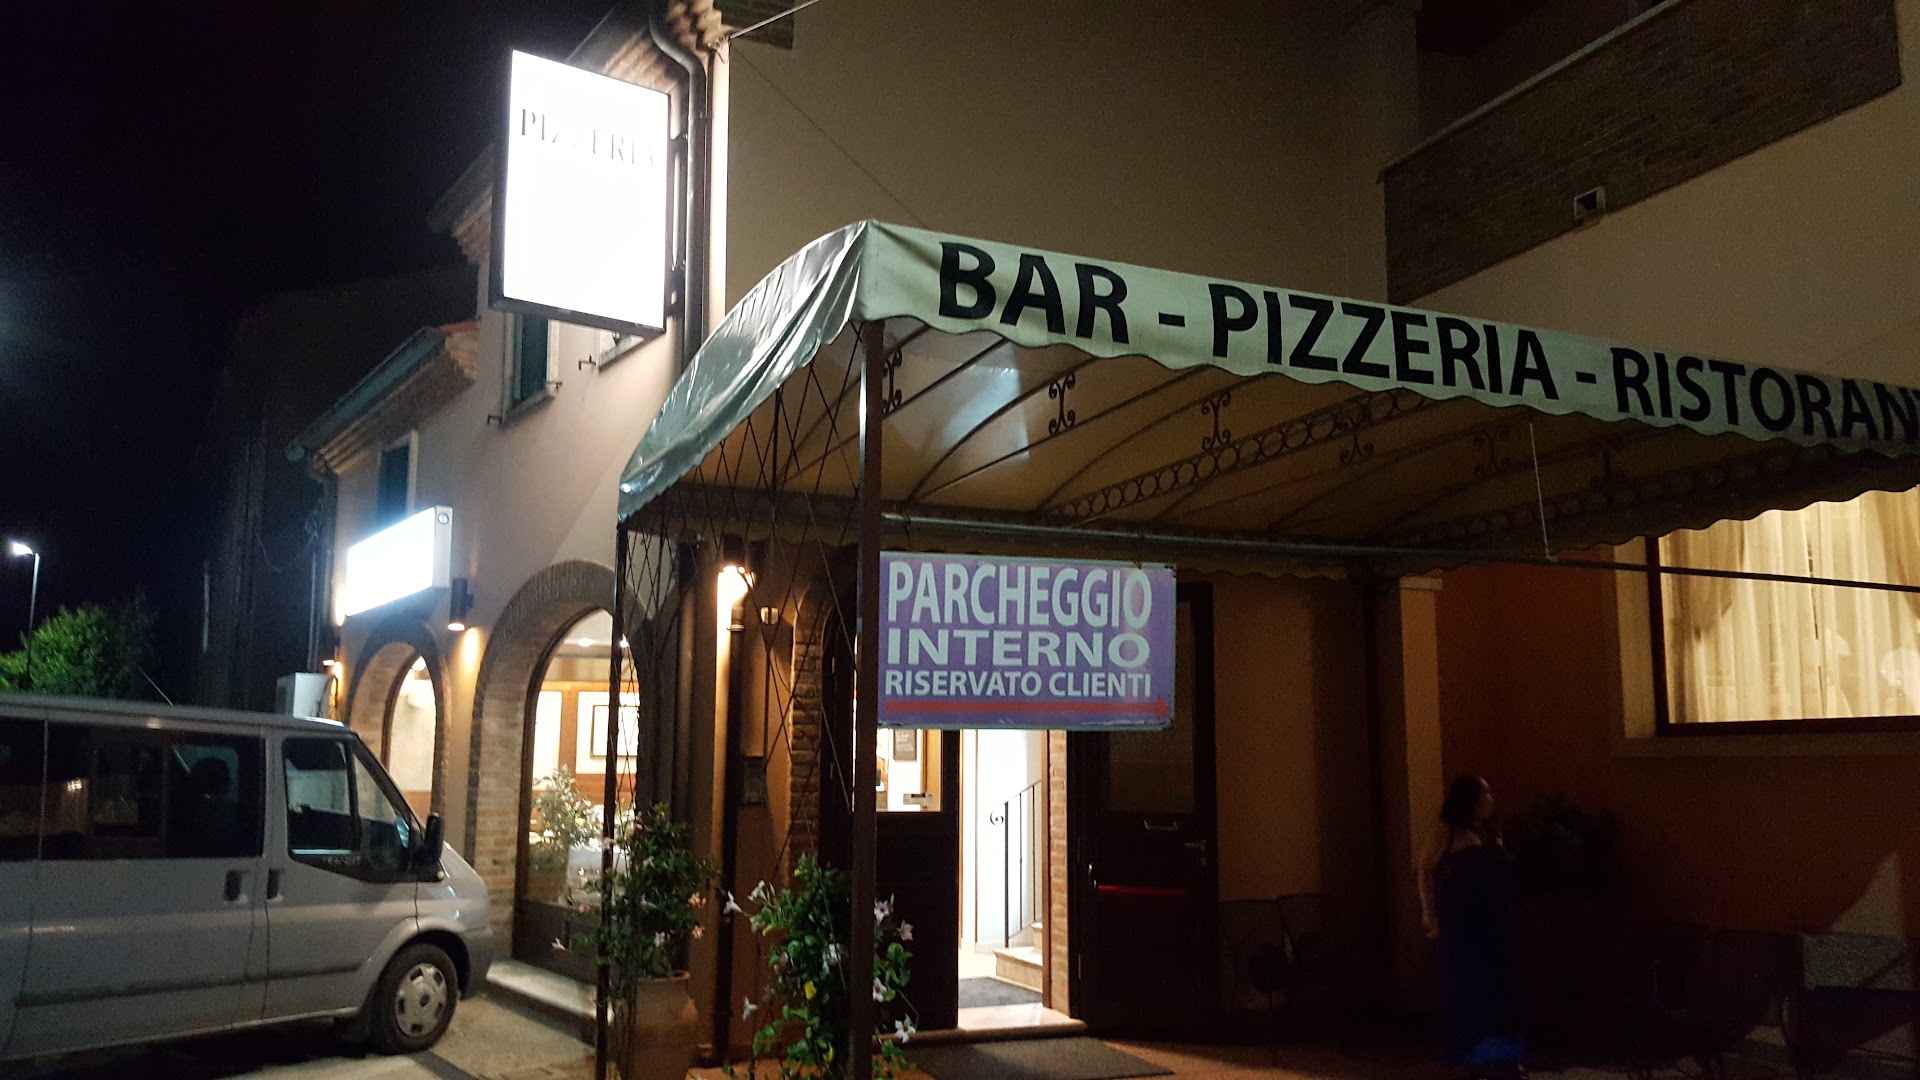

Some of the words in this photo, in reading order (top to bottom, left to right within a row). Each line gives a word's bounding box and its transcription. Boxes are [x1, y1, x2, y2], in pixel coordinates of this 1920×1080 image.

[938, 241, 1130, 345] BAR
[1208, 283, 1560, 401] PIZZERIA
[1609, 346, 1920, 445] RISTORAN
[887, 560, 1152, 629] PARCHEGGIO
[887, 627, 1151, 668] INTERNO
[885, 669, 1042, 697] RISERVATO
[1049, 671, 1151, 698] CLIENTI
